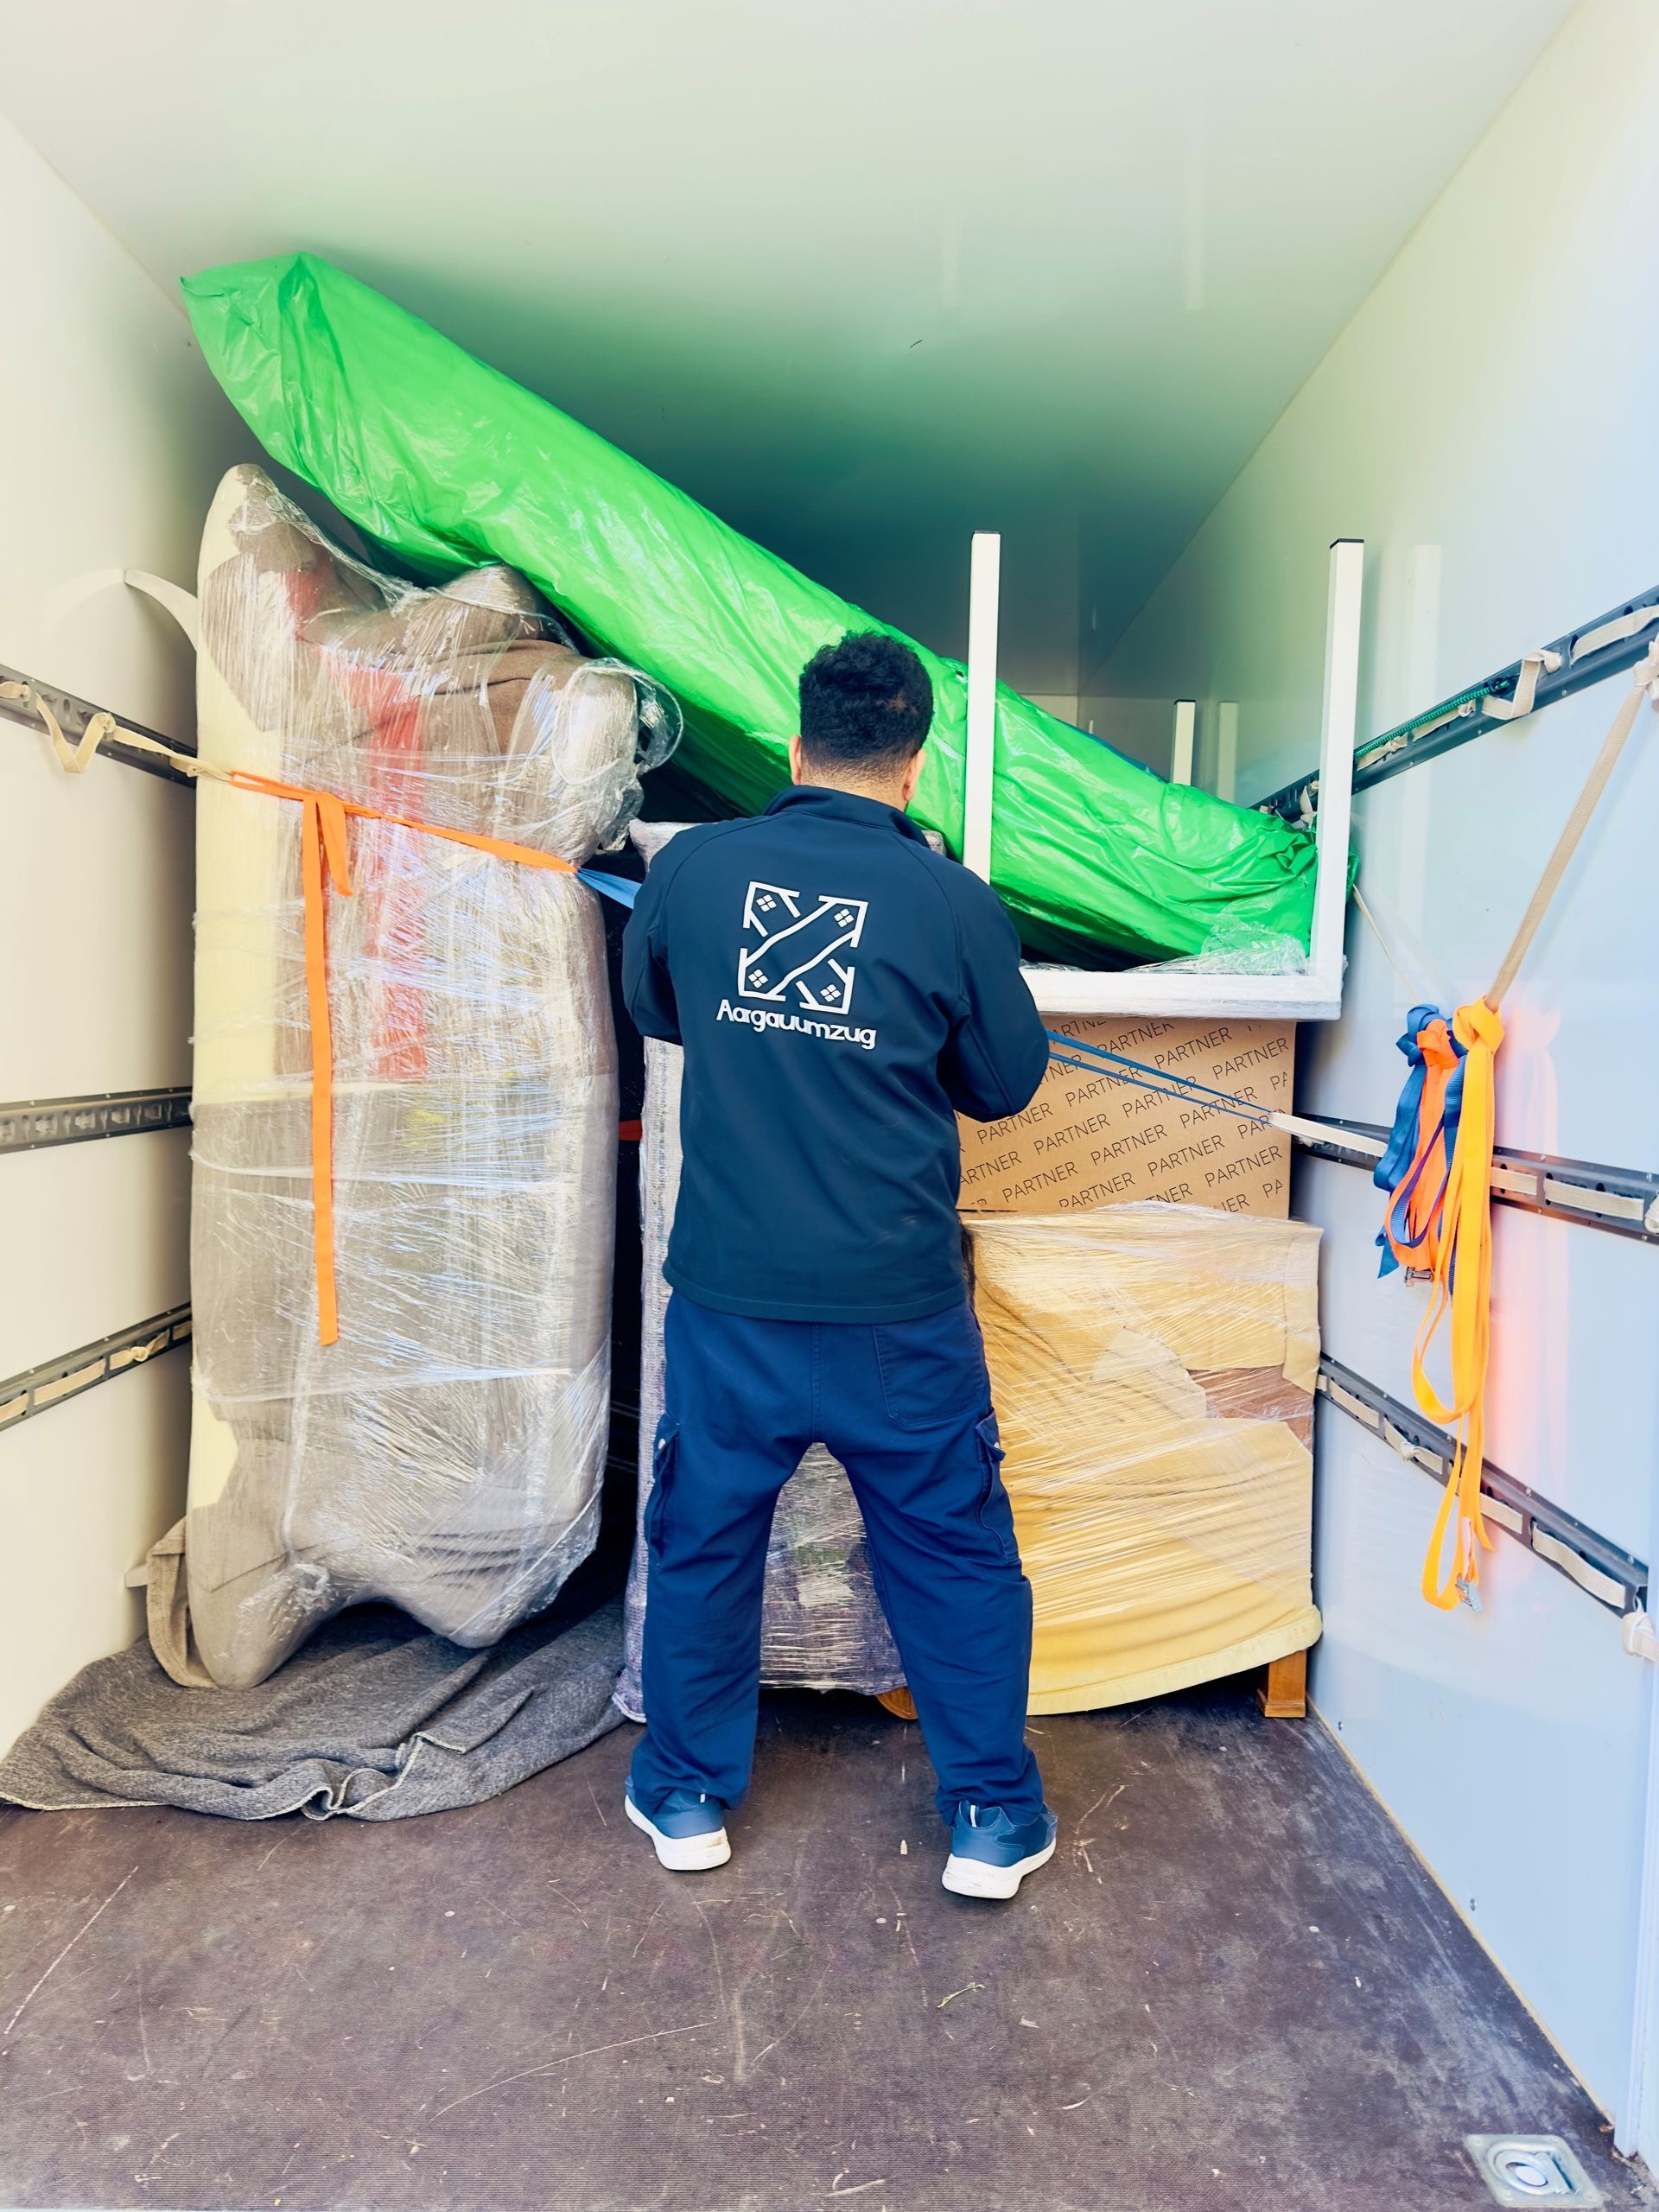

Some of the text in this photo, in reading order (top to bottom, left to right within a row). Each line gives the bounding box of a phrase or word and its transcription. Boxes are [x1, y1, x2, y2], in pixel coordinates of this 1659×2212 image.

[716, 999, 877, 1050] Aargauumzug
[976, 1027, 1232, 1145] PARTNER PARTNER PARTNER
[1033, 1113, 1110, 1155] PARTNER
[1211, 1038, 1289, 1080] PARTNER
[1001, 1161, 1078, 1204] PARTNER
[1090, 1124, 1167, 1166] PARTNER
[1179, 1086, 1258, 1128] PARTNER
[1058, 1173, 1136, 1209] PARTNER
[1147, 1135, 1225, 1177] PARTNER
[1205, 1145, 1282, 1188] PARTNER
